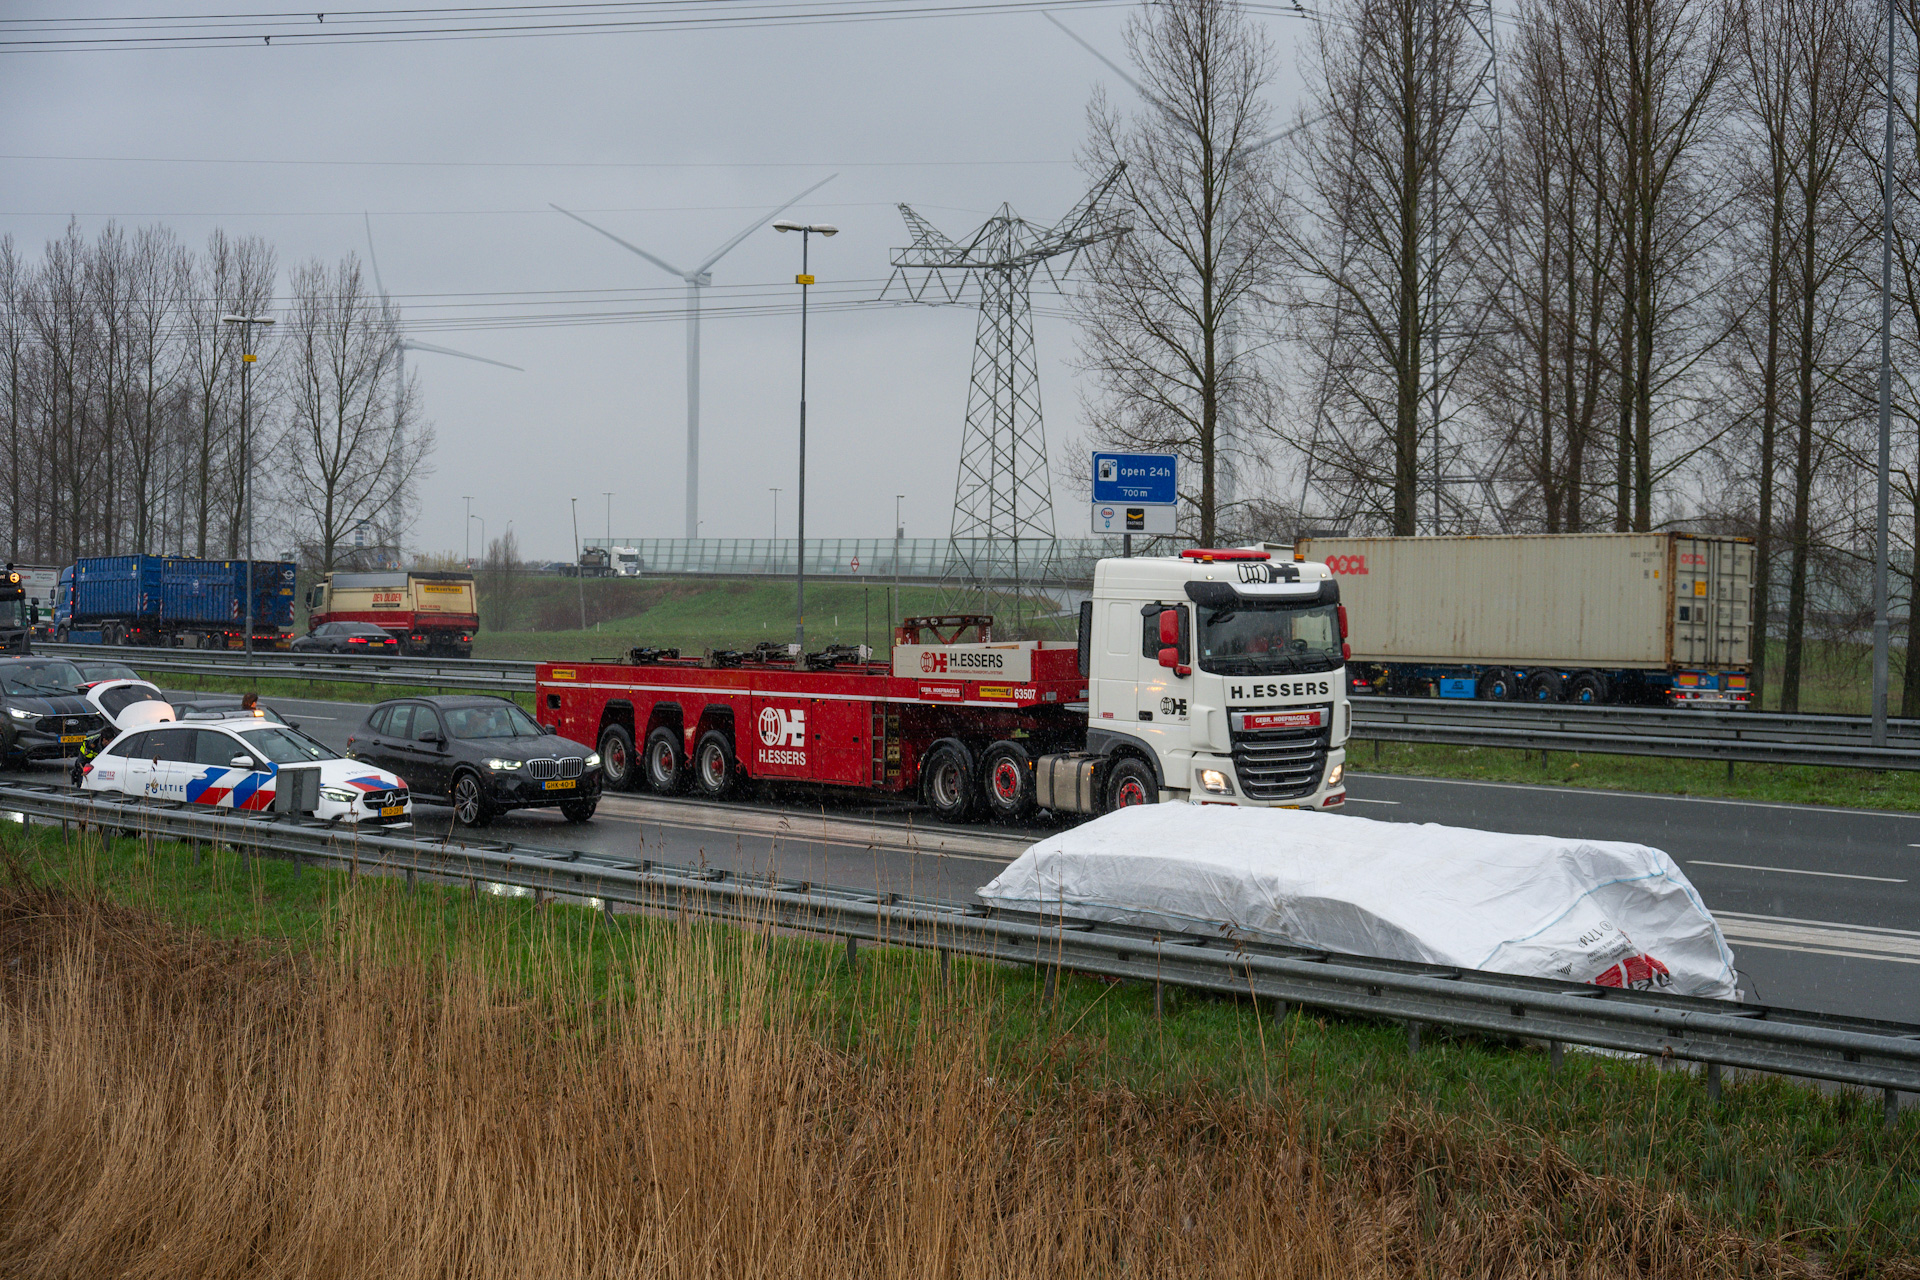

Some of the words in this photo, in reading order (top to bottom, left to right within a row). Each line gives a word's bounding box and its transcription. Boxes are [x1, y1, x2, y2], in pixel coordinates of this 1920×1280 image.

[1121, 468, 1146, 477] open
[1149, 467, 1170, 477] 24h
[1122, 489, 1138, 497] 700
[1680, 553, 1706, 565] OOCL
[1325, 555, 1369, 575] OOCL
[949, 653, 1003, 668] H.ESSERS
[1014, 688, 1036, 699] 63507
[1231, 682, 1329, 699] H.ESSERS
[1273, 714, 1310, 722] HOEFNAGELS
[758, 749, 806, 766] H.ESSERS
[145, 782, 183, 793] POLITIE
